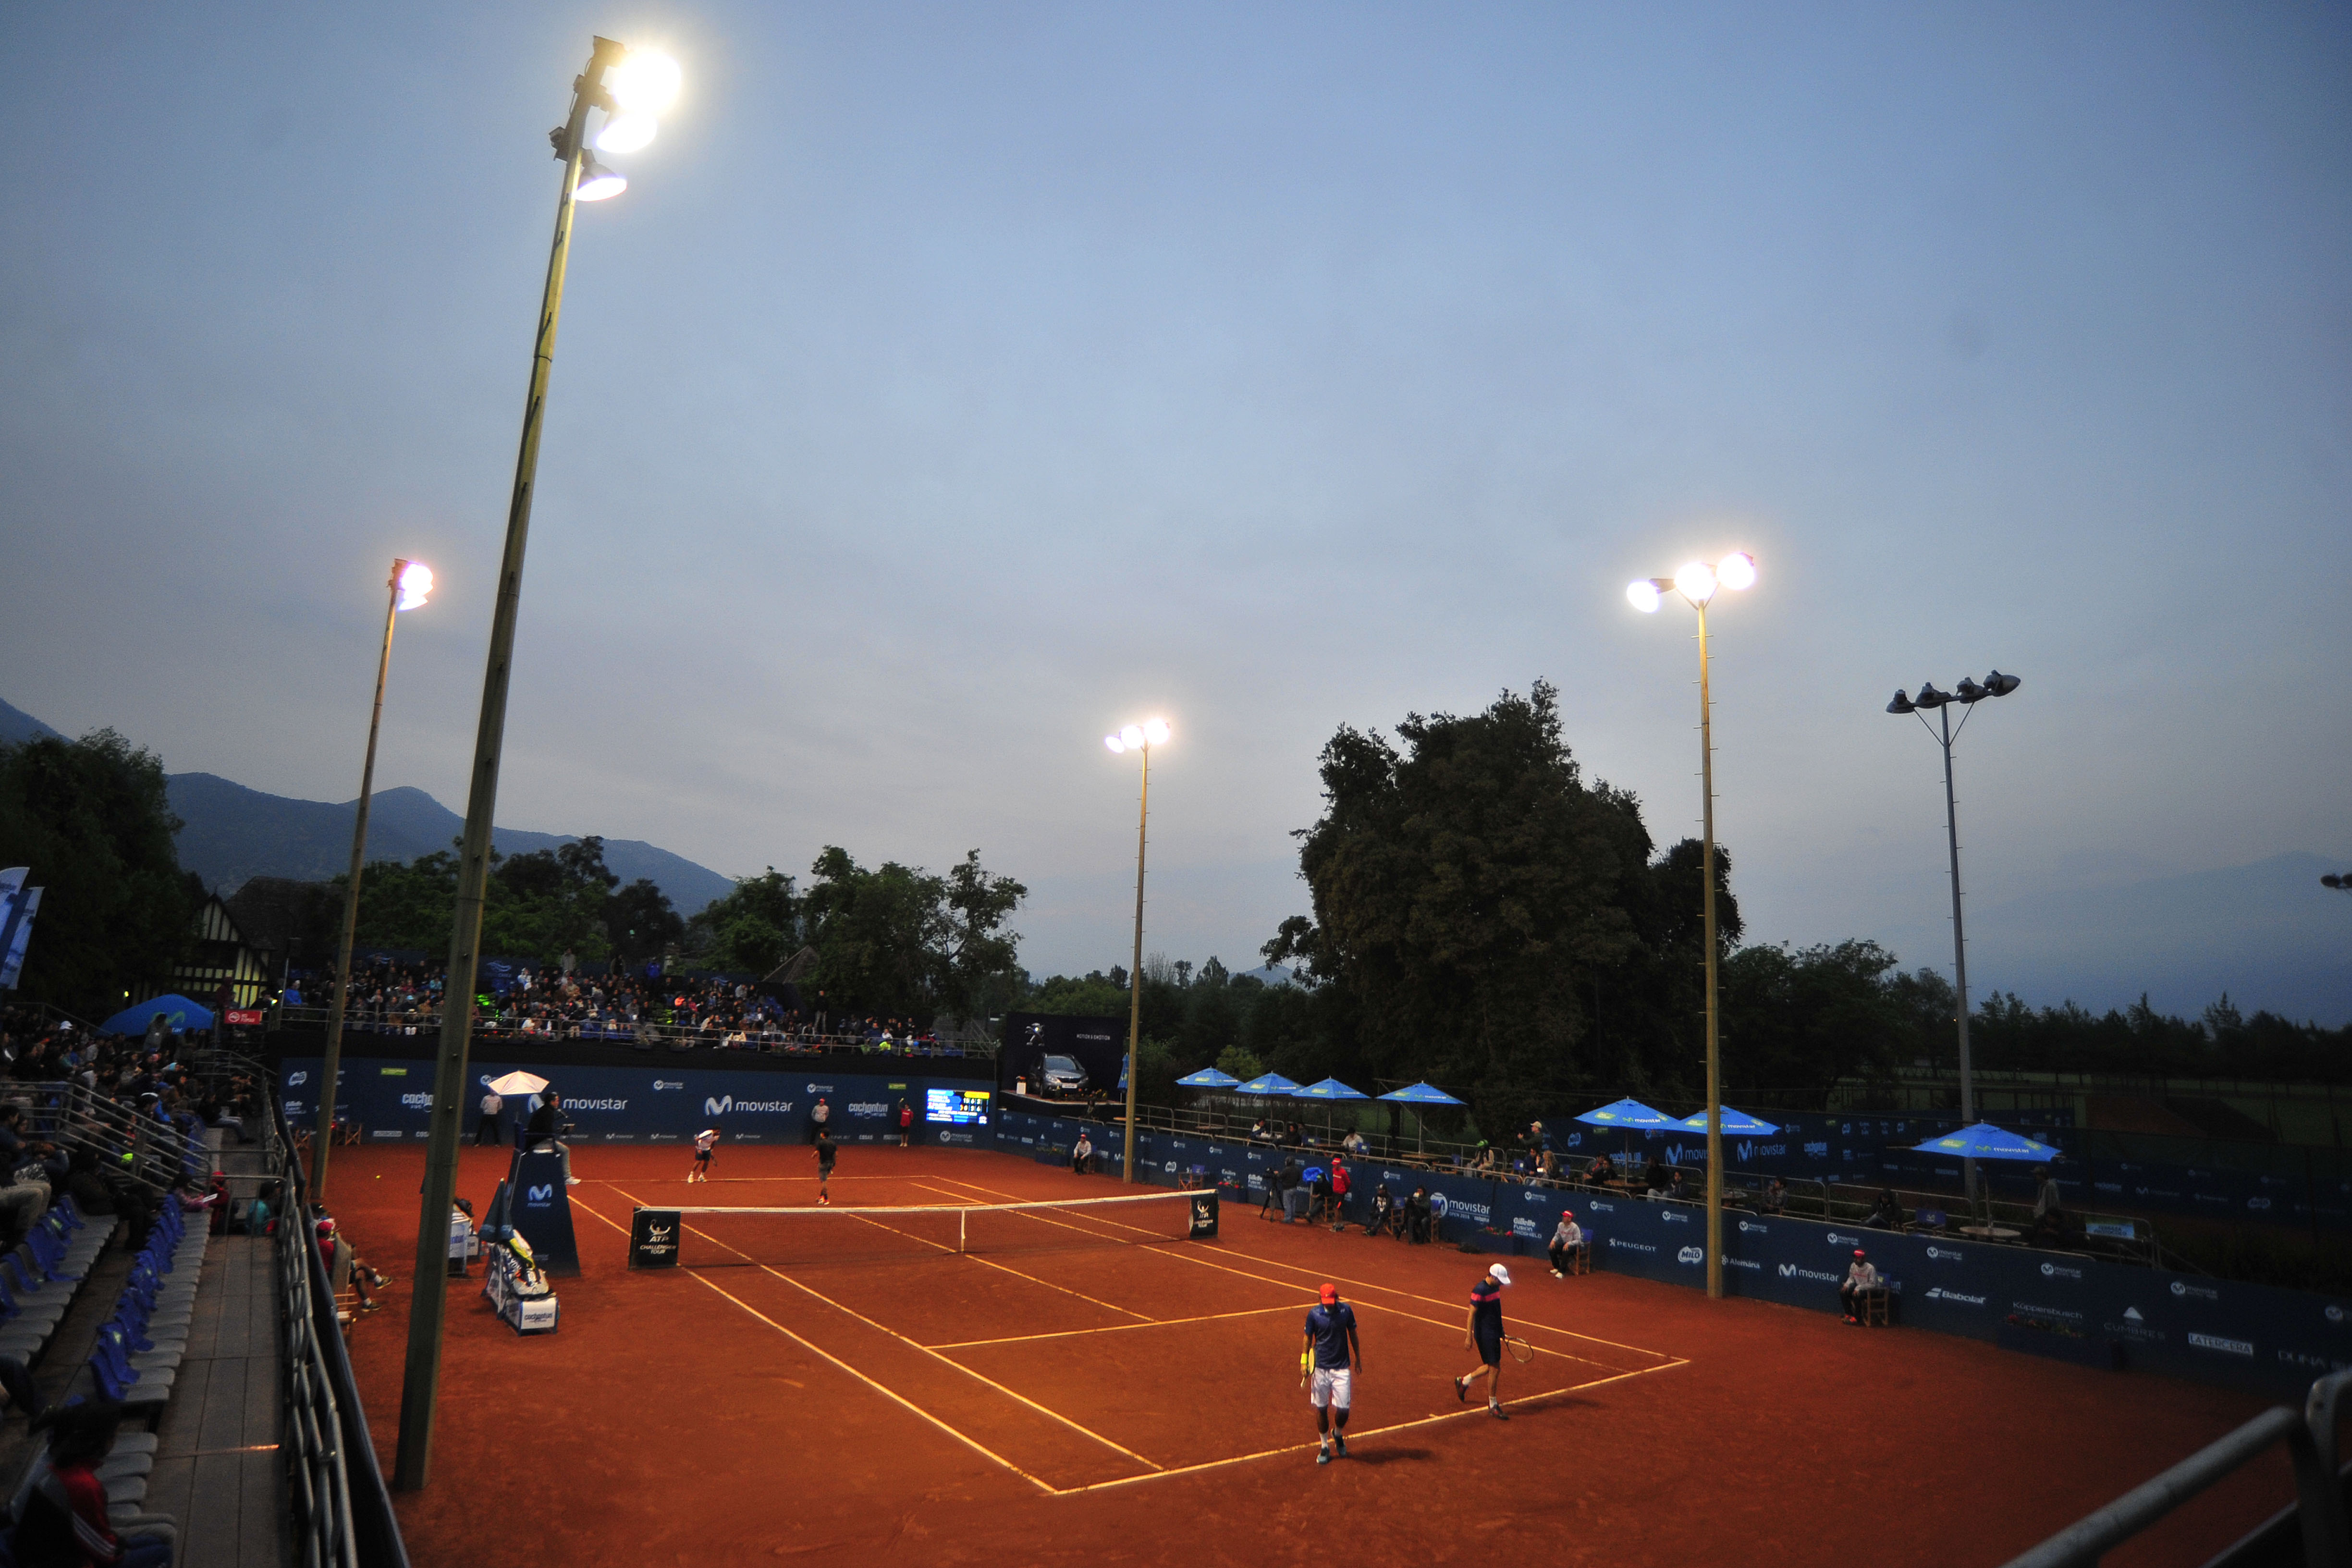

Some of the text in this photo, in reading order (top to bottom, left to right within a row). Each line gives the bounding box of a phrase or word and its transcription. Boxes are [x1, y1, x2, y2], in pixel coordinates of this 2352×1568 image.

[563, 1098, 628, 1110] movistar
[736, 1101, 793, 1112] movistar
[1449, 1200, 1490, 1214] movistar
[1513, 1217, 1536, 1227] Gillette
[1617, 1241, 1657, 1252] PEUGEOT
[1681, 1250, 1700, 1259] MILO
[1799, 1269, 1839, 1283] movistar
[1941, 1290, 1986, 1304] Babolat
